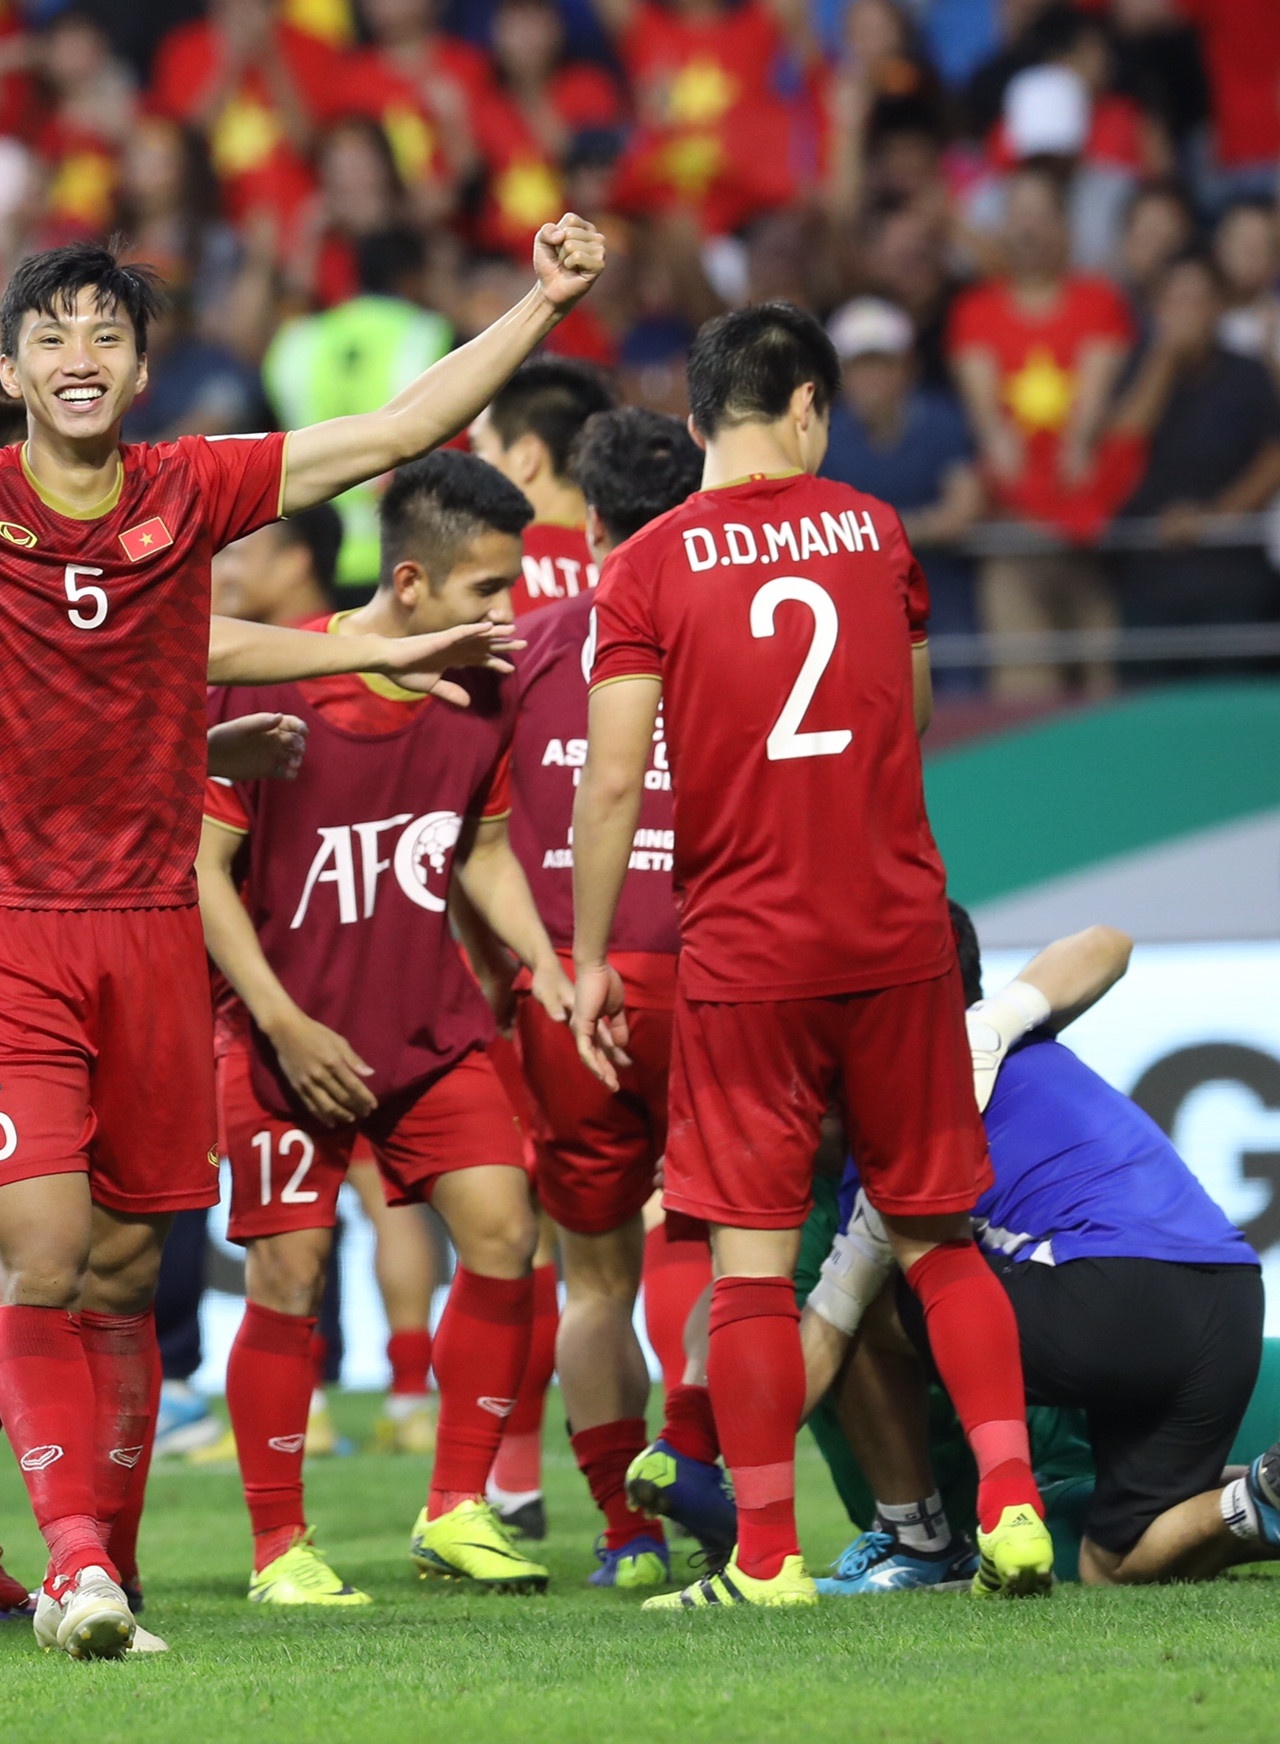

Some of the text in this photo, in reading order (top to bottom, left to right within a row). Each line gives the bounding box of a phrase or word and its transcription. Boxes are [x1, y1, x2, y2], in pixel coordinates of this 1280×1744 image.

[682, 510, 880, 572] D.D.MANH
[64, 563, 108, 629] 5
[750, 576, 852, 761] 2
[290, 810, 462, 929] AFC
[251, 1128, 319, 1206] 12
